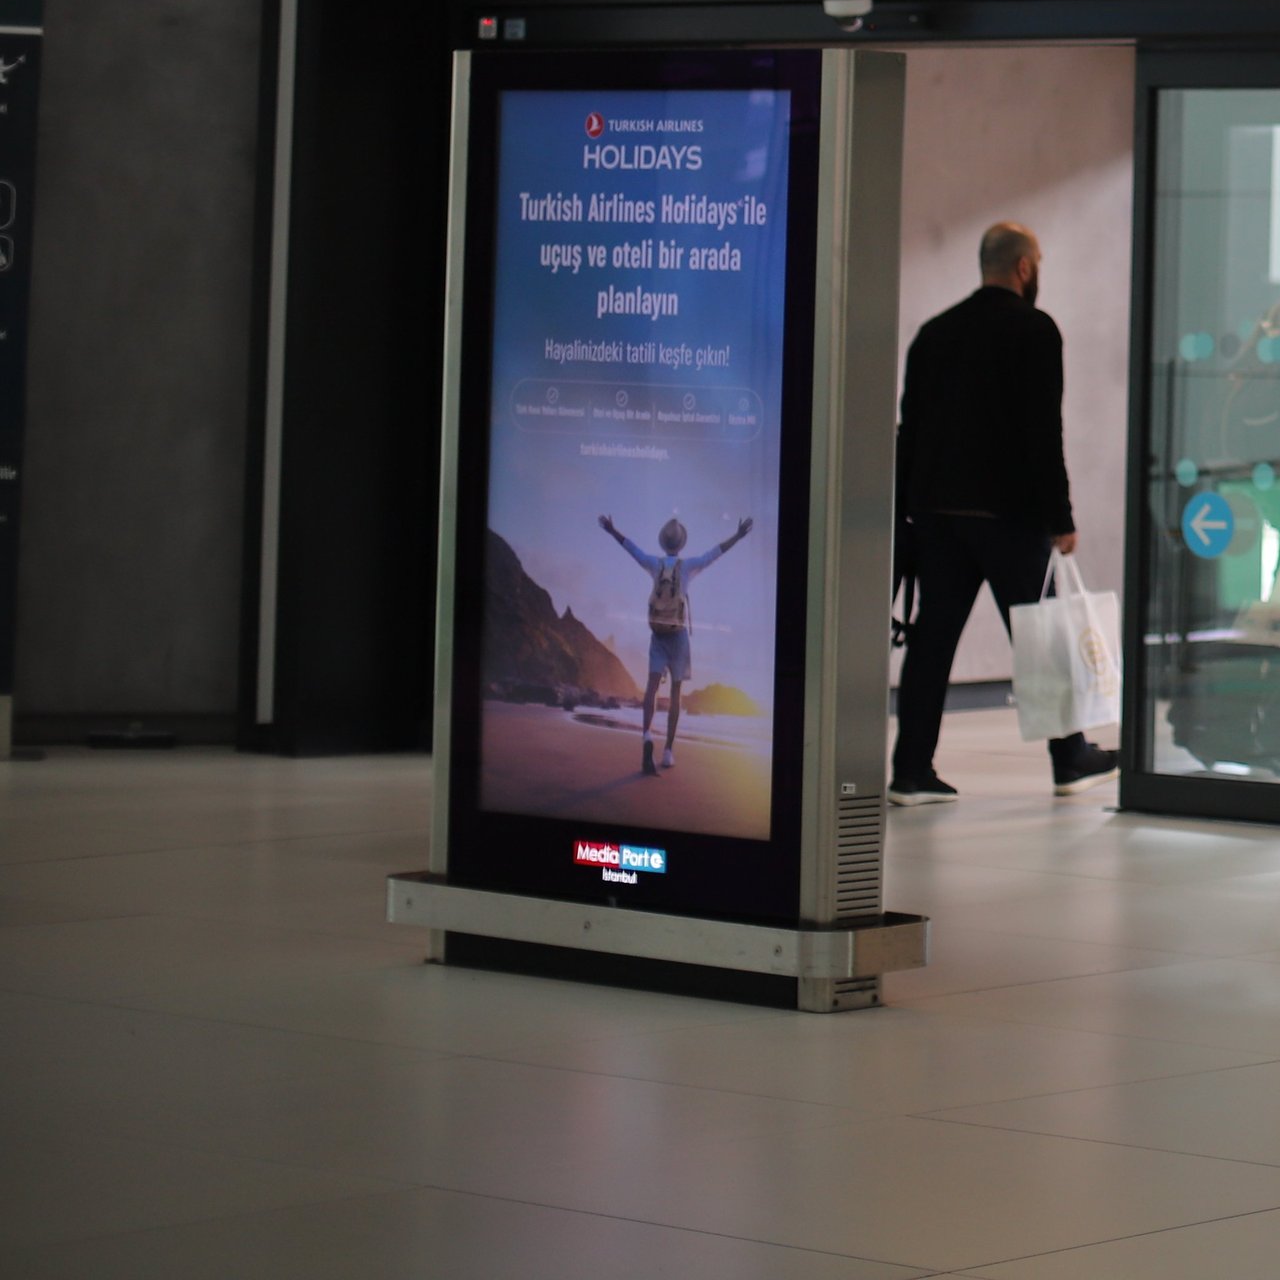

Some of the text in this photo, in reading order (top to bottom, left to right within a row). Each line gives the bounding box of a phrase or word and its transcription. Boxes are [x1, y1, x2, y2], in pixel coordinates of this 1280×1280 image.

[608, 118, 704, 134] TURKISH AIRLINES
[582, 145, 703, 171] HOLIDAYS
[519, 192, 583, 223] Turkish
[588, 194, 655, 224] Airlines
[540, 239, 742, 274] uçuş ve oteli bir arada
[596, 285, 679, 321] planlayın
[545, 338, 624, 366] Hayalinizdeki
[626, 339, 655, 365] tatili
[658, 342, 693, 368] keşfe
[576, 840, 649, 868] Media Port
